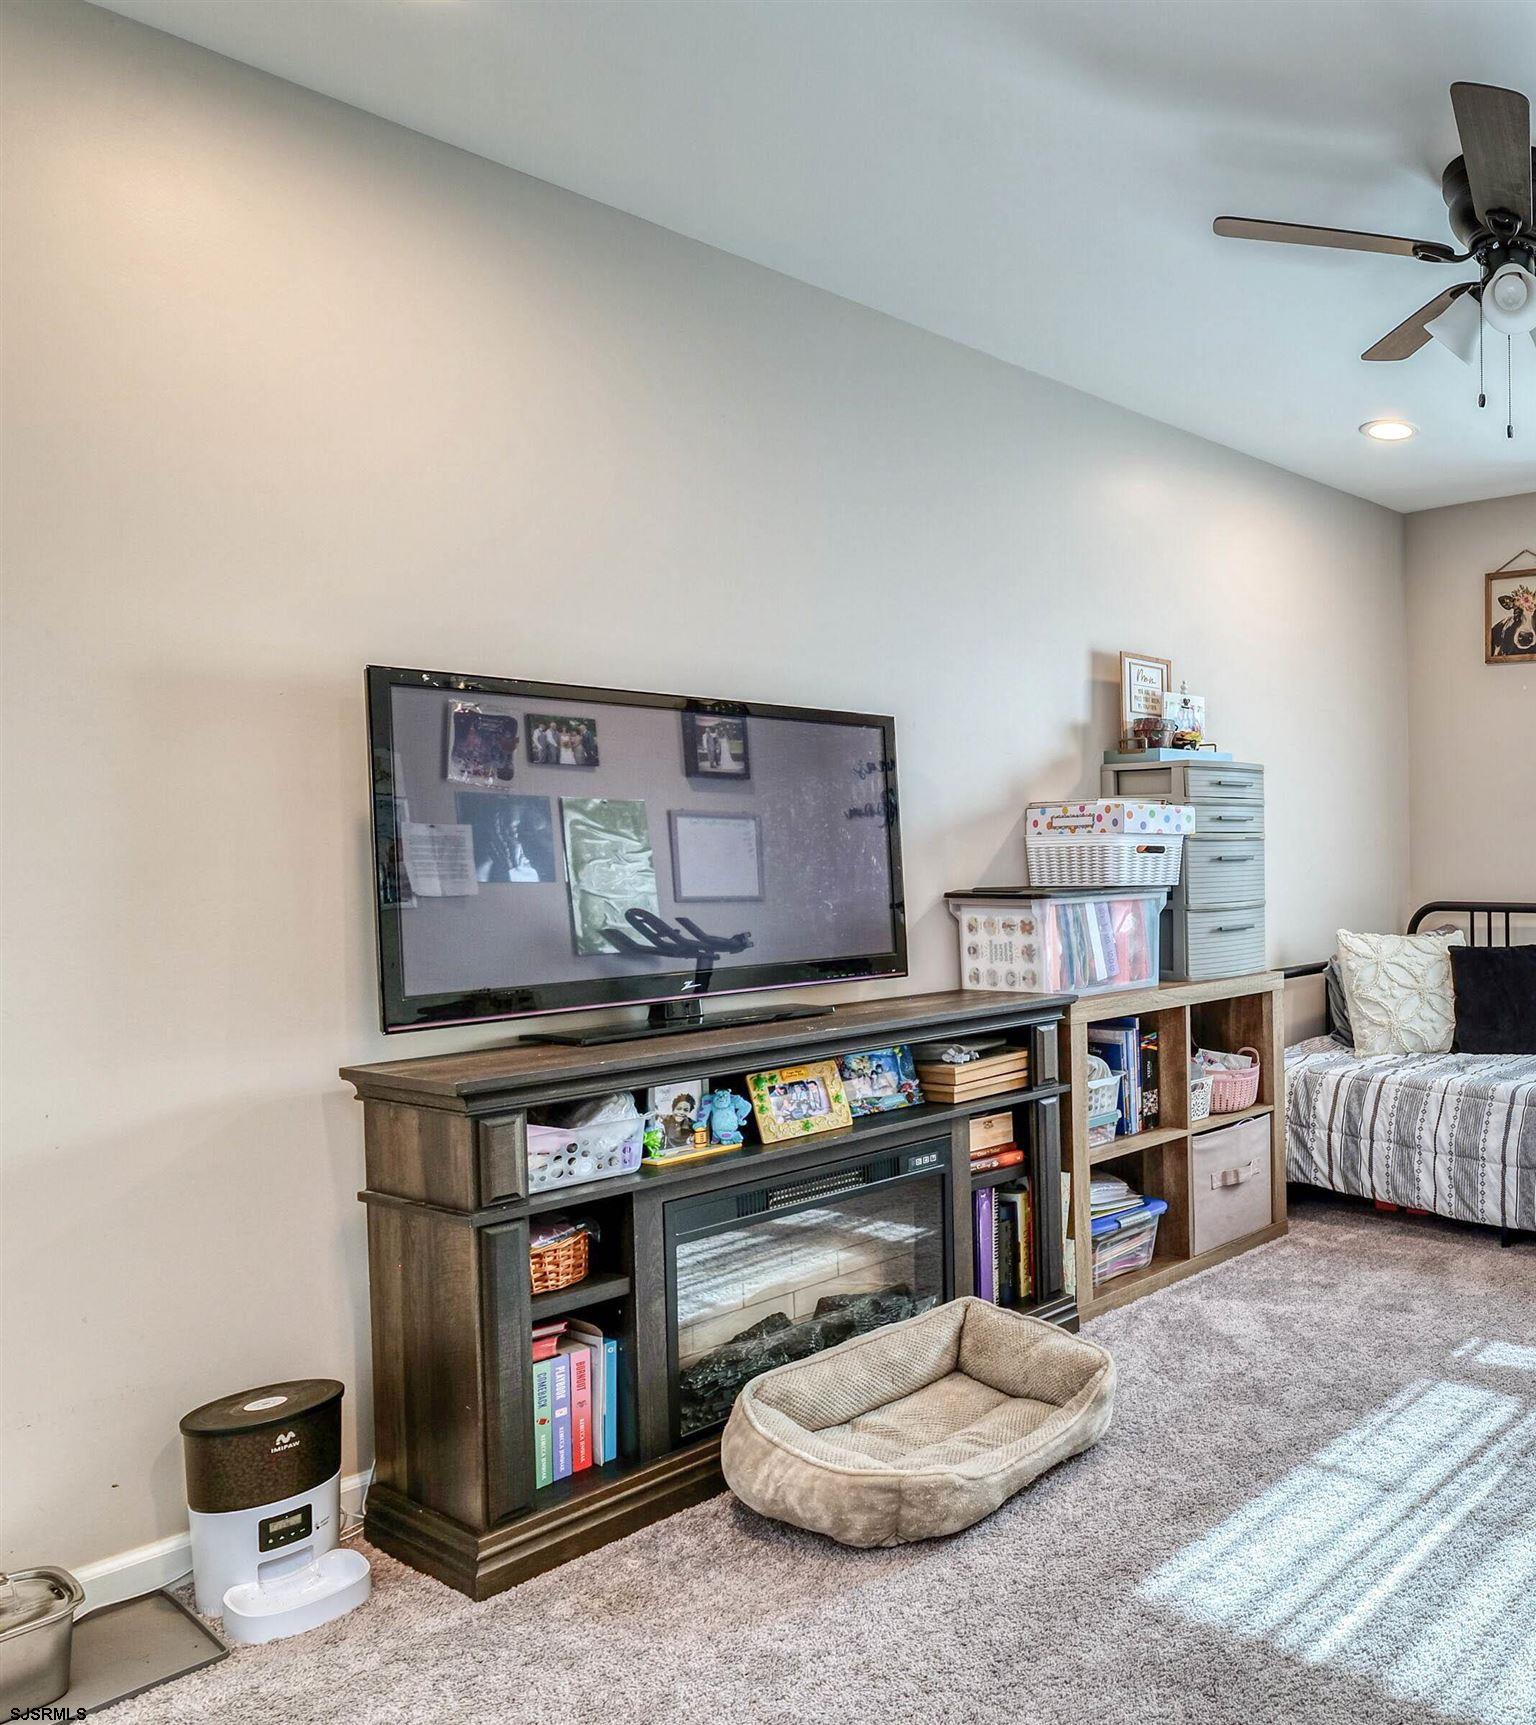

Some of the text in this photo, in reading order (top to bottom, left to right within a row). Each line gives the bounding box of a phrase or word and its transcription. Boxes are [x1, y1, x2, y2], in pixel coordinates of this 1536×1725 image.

[536, 1372, 547, 1410] COMEBACK
[555, 1365, 566, 1401] PLAYBOOK
[575, 1361, 587, 1392] BURNOUT
[270, 1440, 301, 1454] IMIPAW
